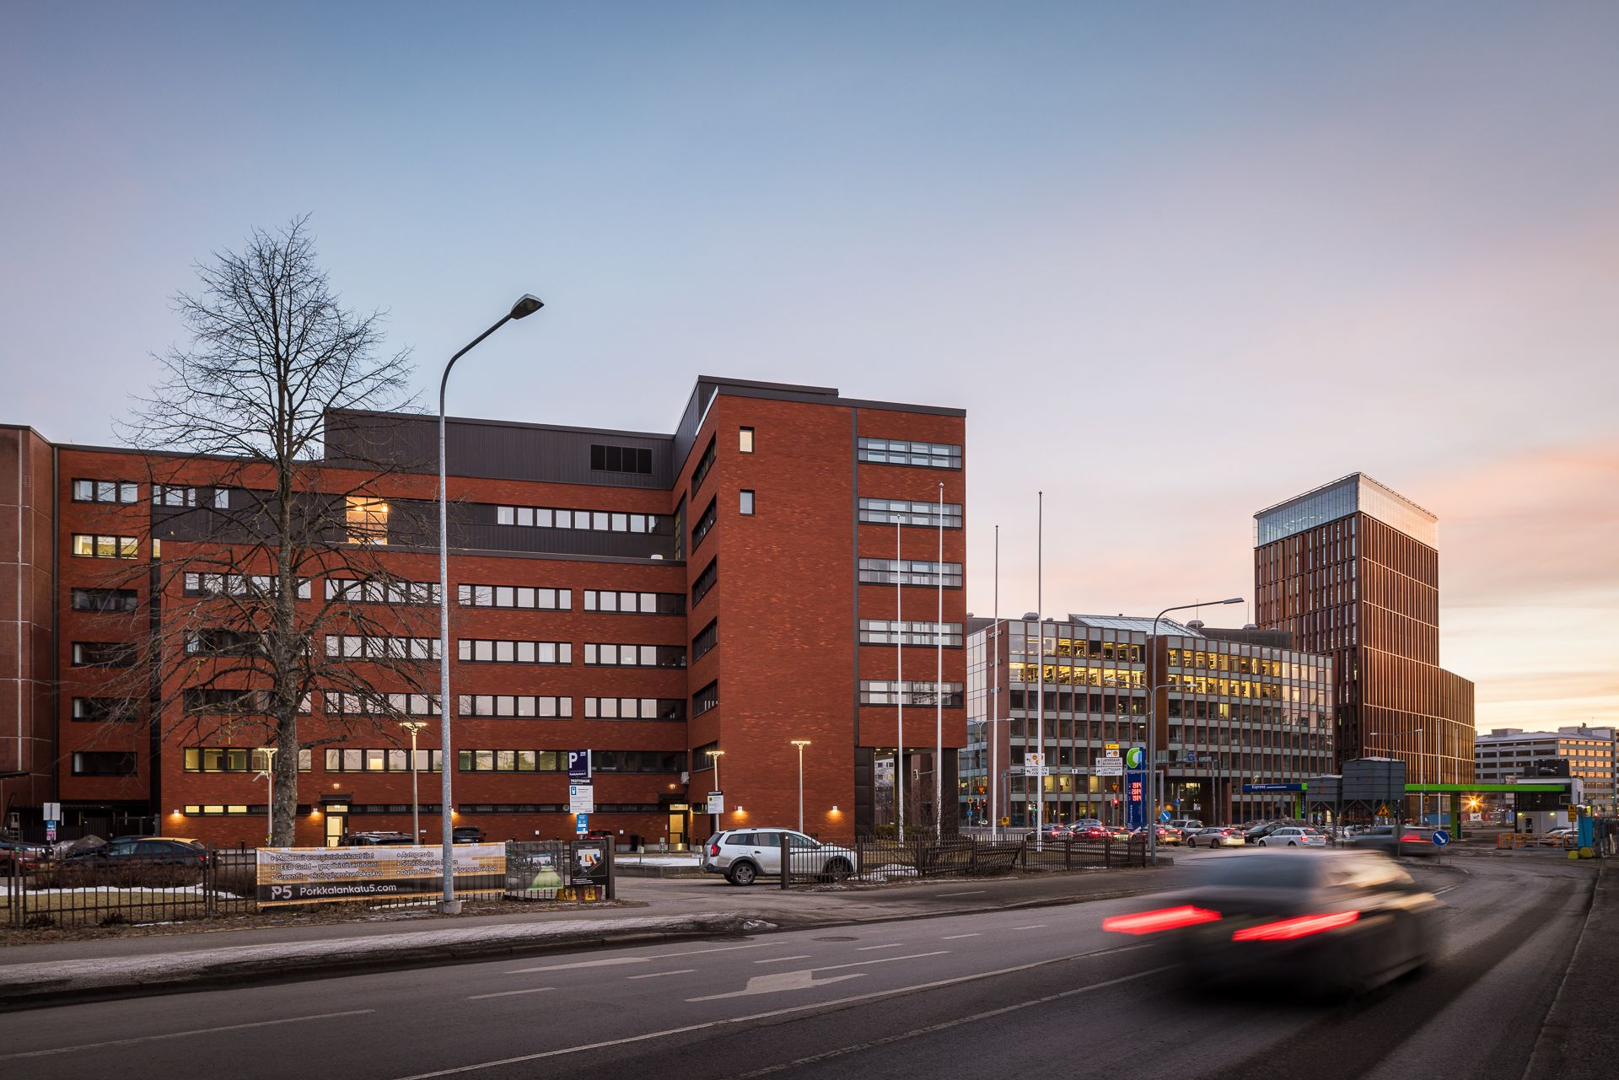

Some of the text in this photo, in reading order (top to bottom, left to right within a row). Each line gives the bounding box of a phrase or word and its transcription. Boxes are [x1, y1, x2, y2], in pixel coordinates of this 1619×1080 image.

[568, 752, 578, 769] P
[271, 884, 397, 900] P5 Porkkalankatu5.com
